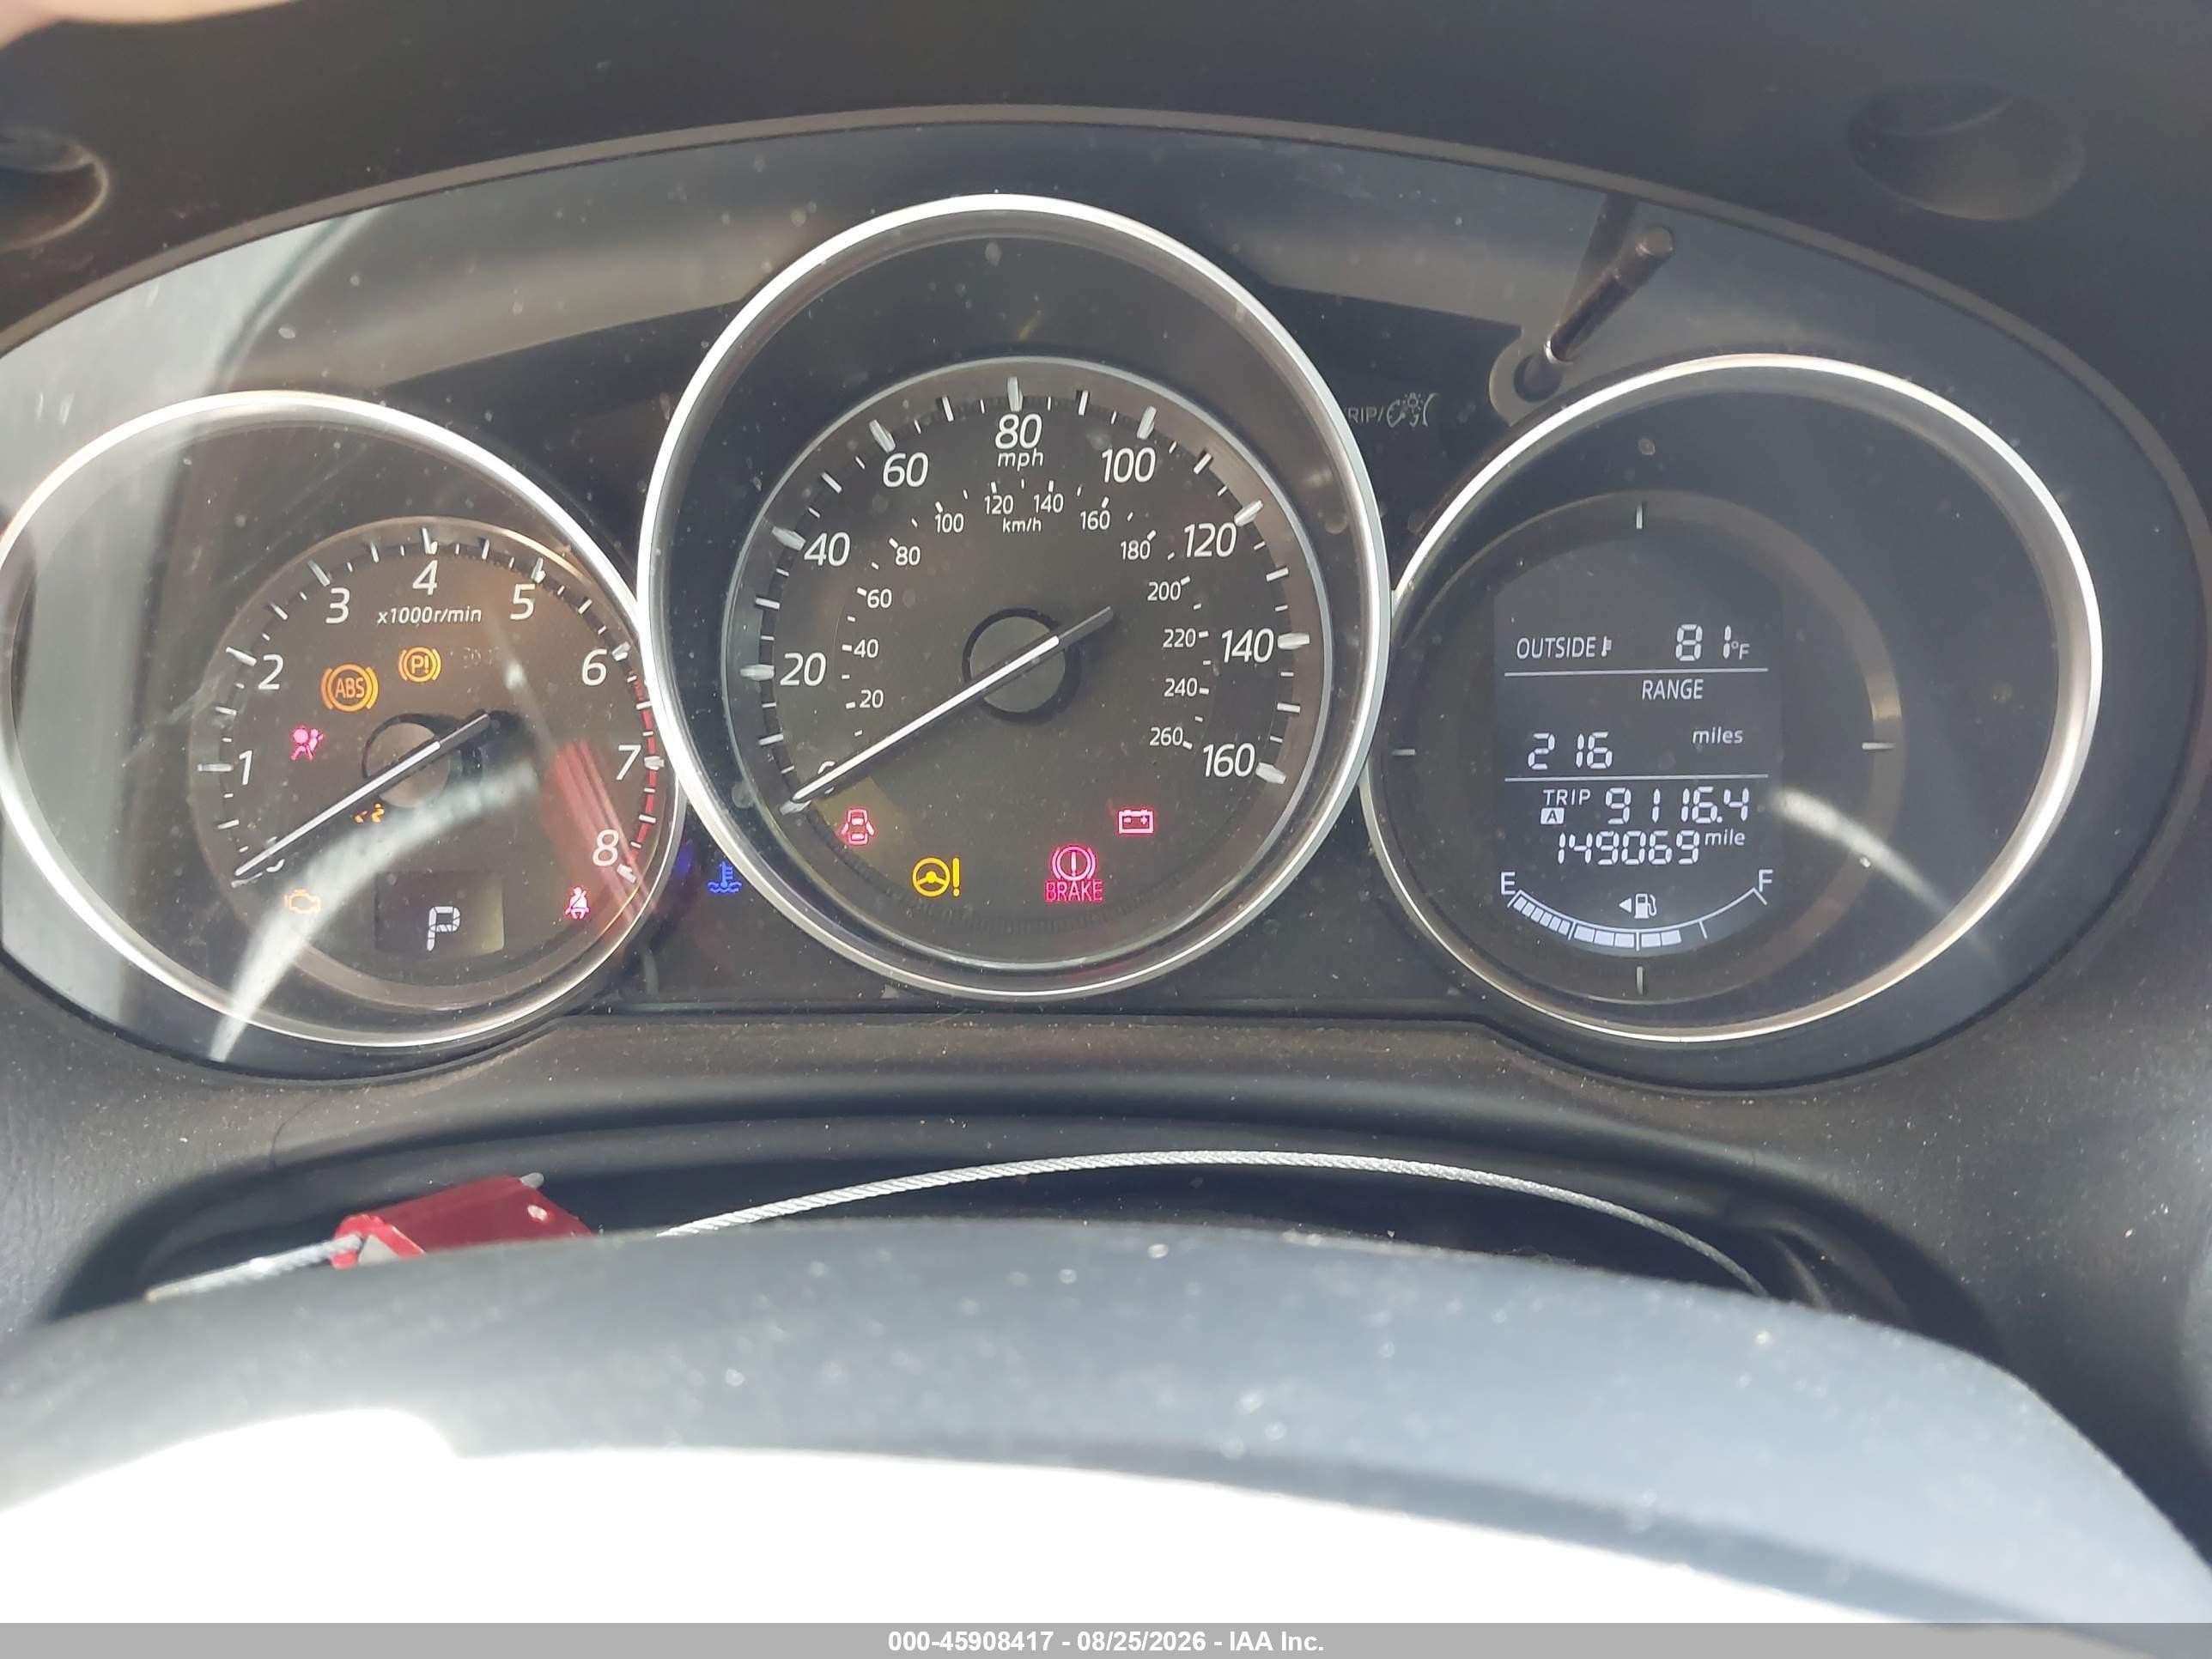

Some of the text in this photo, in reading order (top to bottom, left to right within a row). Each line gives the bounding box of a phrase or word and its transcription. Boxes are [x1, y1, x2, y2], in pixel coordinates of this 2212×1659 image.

[1346, 406, 1384, 423] RIP/
[994, 413, 1042, 450] 80
[882, 452, 928, 488] 60
[997, 448, 1044, 471] mph
[1101, 447, 1156, 483] 100
[983, 495, 1014, 515] 120
[1033, 493, 1064, 514] 140
[934, 513, 964, 533] 100
[1002, 517, 1042, 533] km/h
[1079, 510, 1110, 531] 160
[803, 532, 851, 567] 40
[1120, 540, 1151, 561] 180
[1183, 522, 1237, 558] 120
[895, 545, 921, 567] 80
[412, 560, 438, 596] 4
[509, 583, 536, 621] 5
[866, 588, 893, 609] 60
[1146, 580, 1182, 602] 200
[325, 587, 351, 624] 3
[377, 605, 482, 625] x1000r/min
[853, 639, 879, 659] 40
[1162, 629, 1196, 648] 220
[1220, 628, 1274, 664] 140
[1516, 636, 1597, 659] OUTSIDE
[257, 653, 284, 690] 2
[580, 649, 608, 686] 6
[779, 652, 827, 687] 20
[335, 677, 365, 699] ABS
[859, 690, 884, 708] 20
[1164, 678, 1198, 698] 240
[1641, 678, 1705, 701] RANGE
[1149, 726, 1183, 746] 260
[1527, 726, 1744, 770] 216 miles
[237, 750, 254, 786] 1
[616, 744, 642, 781] 7
[1202, 742, 1255, 778] 160
[1542, 788, 1591, 806] TRIP
[592, 829, 621, 866] 8
[1557, 830, 1747, 866] 149069 mile
[1045, 880, 1103, 902] BRAKE
[1500, 872, 1516, 896] E
[1758, 869, 1774, 892] F
[426, 905, 461, 951] P
